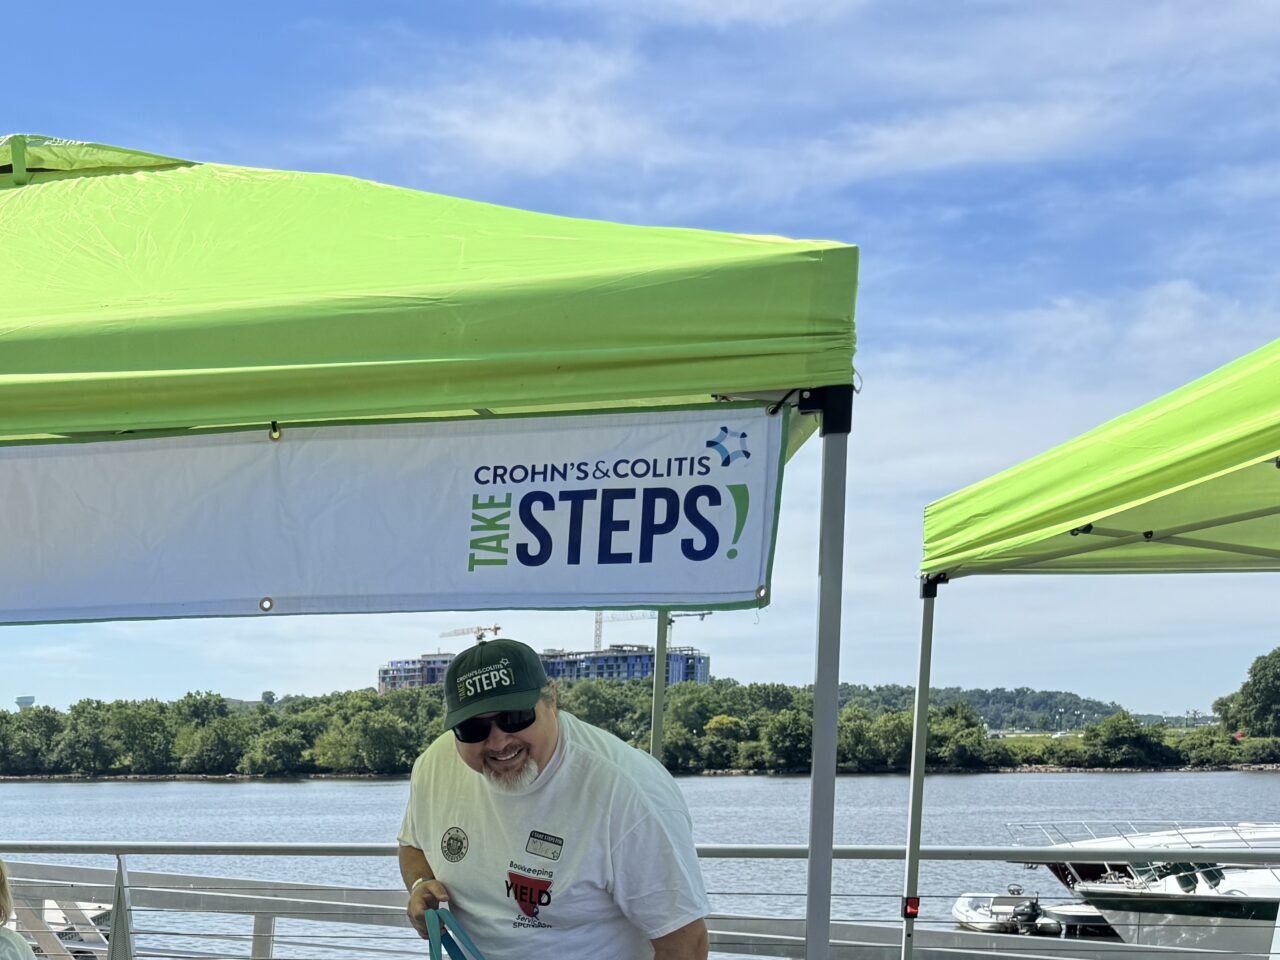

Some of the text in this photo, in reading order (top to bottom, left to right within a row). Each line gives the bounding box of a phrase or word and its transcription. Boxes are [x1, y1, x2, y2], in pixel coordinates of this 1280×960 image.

[467, 492, 513, 572] TAKE
[516, 484, 750, 567] STEPS!
[505, 880, 551, 907] YIELD
[509, 861, 553, 878] Bookkeeping
